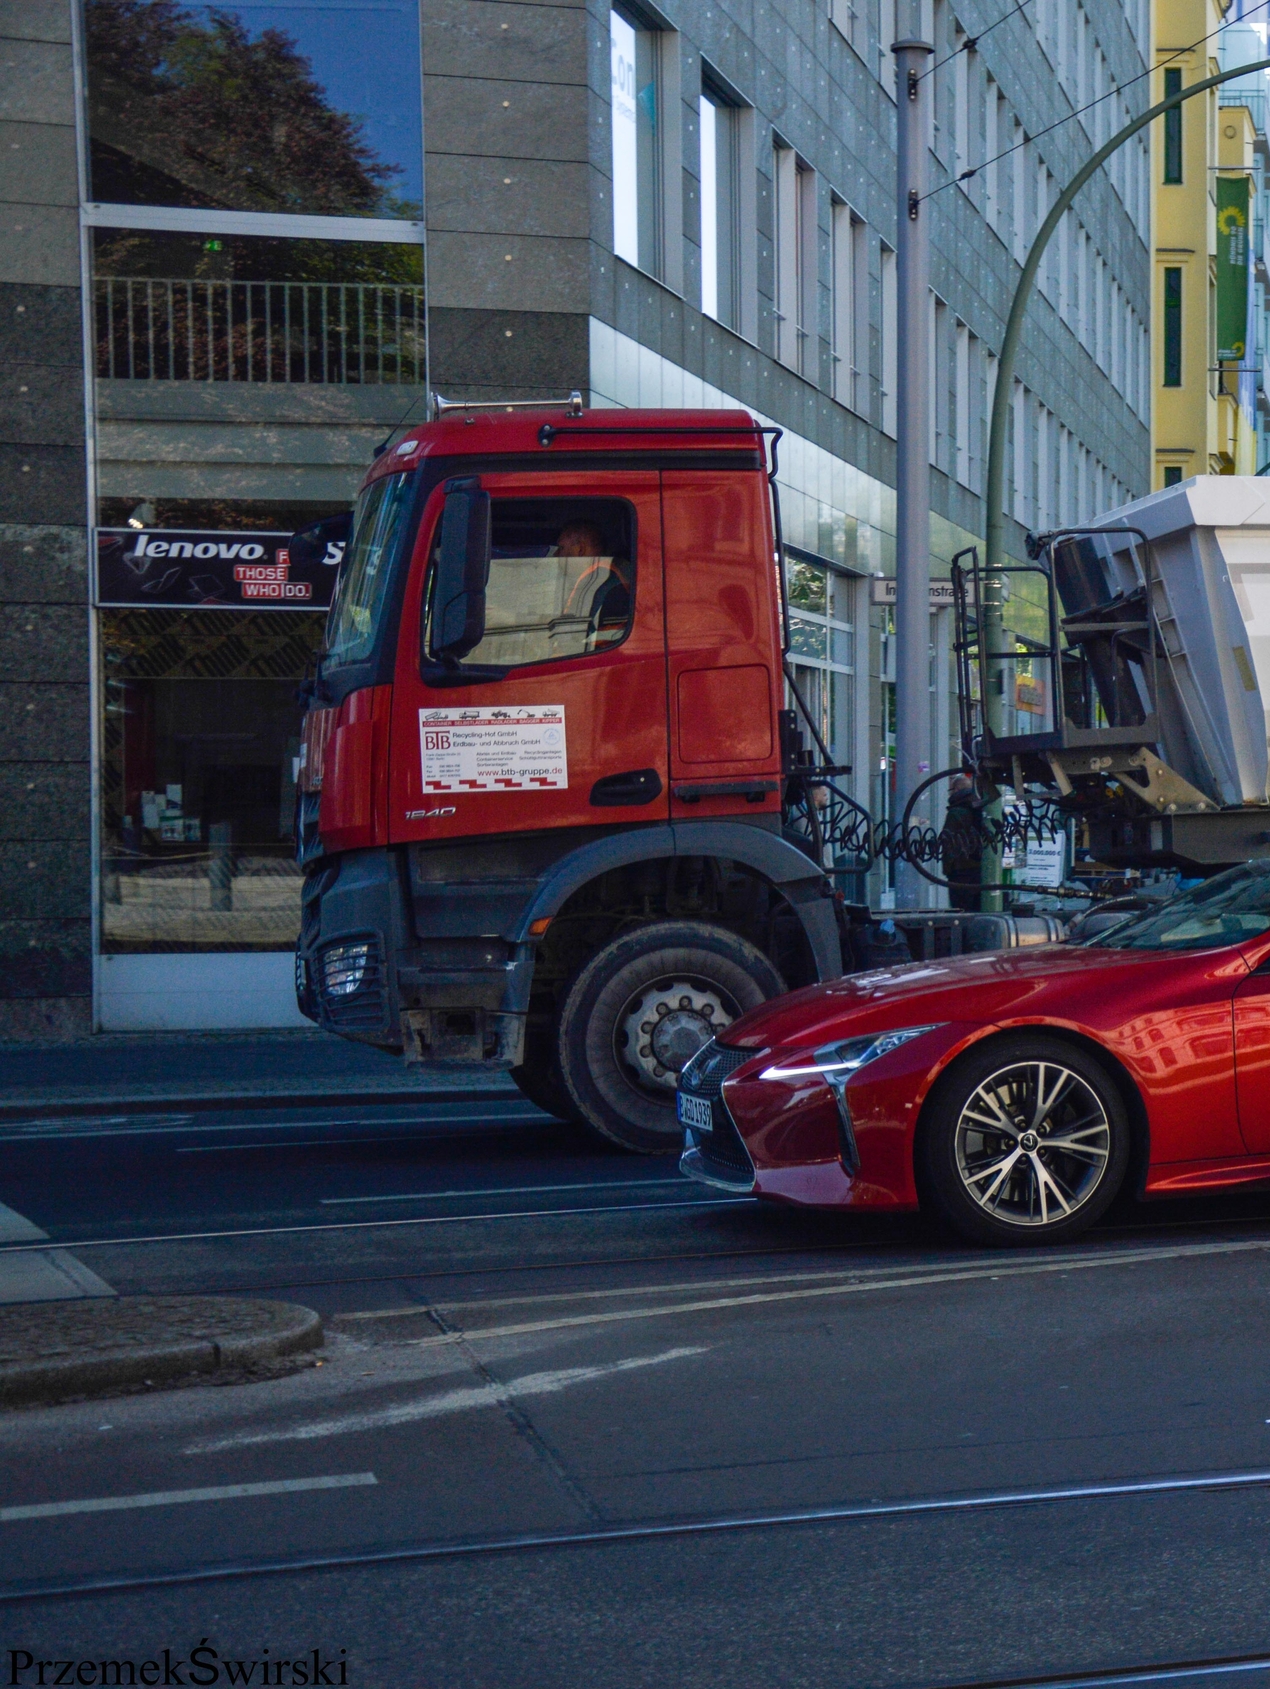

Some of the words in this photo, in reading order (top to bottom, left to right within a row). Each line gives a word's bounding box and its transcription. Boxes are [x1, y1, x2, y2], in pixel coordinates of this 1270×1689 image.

[134, 534, 265, 560] lenovo
[236, 567, 286, 581] THOSE
[245, 584, 281, 598] WHO
[286, 585, 311, 598] DO.
[425, 730, 451, 750] BTB
[452, 731, 496, 740] Recycling-Hof
[477, 766, 562, 777] www.btb-gruppe.de
[405, 806, 456, 820] 1840
